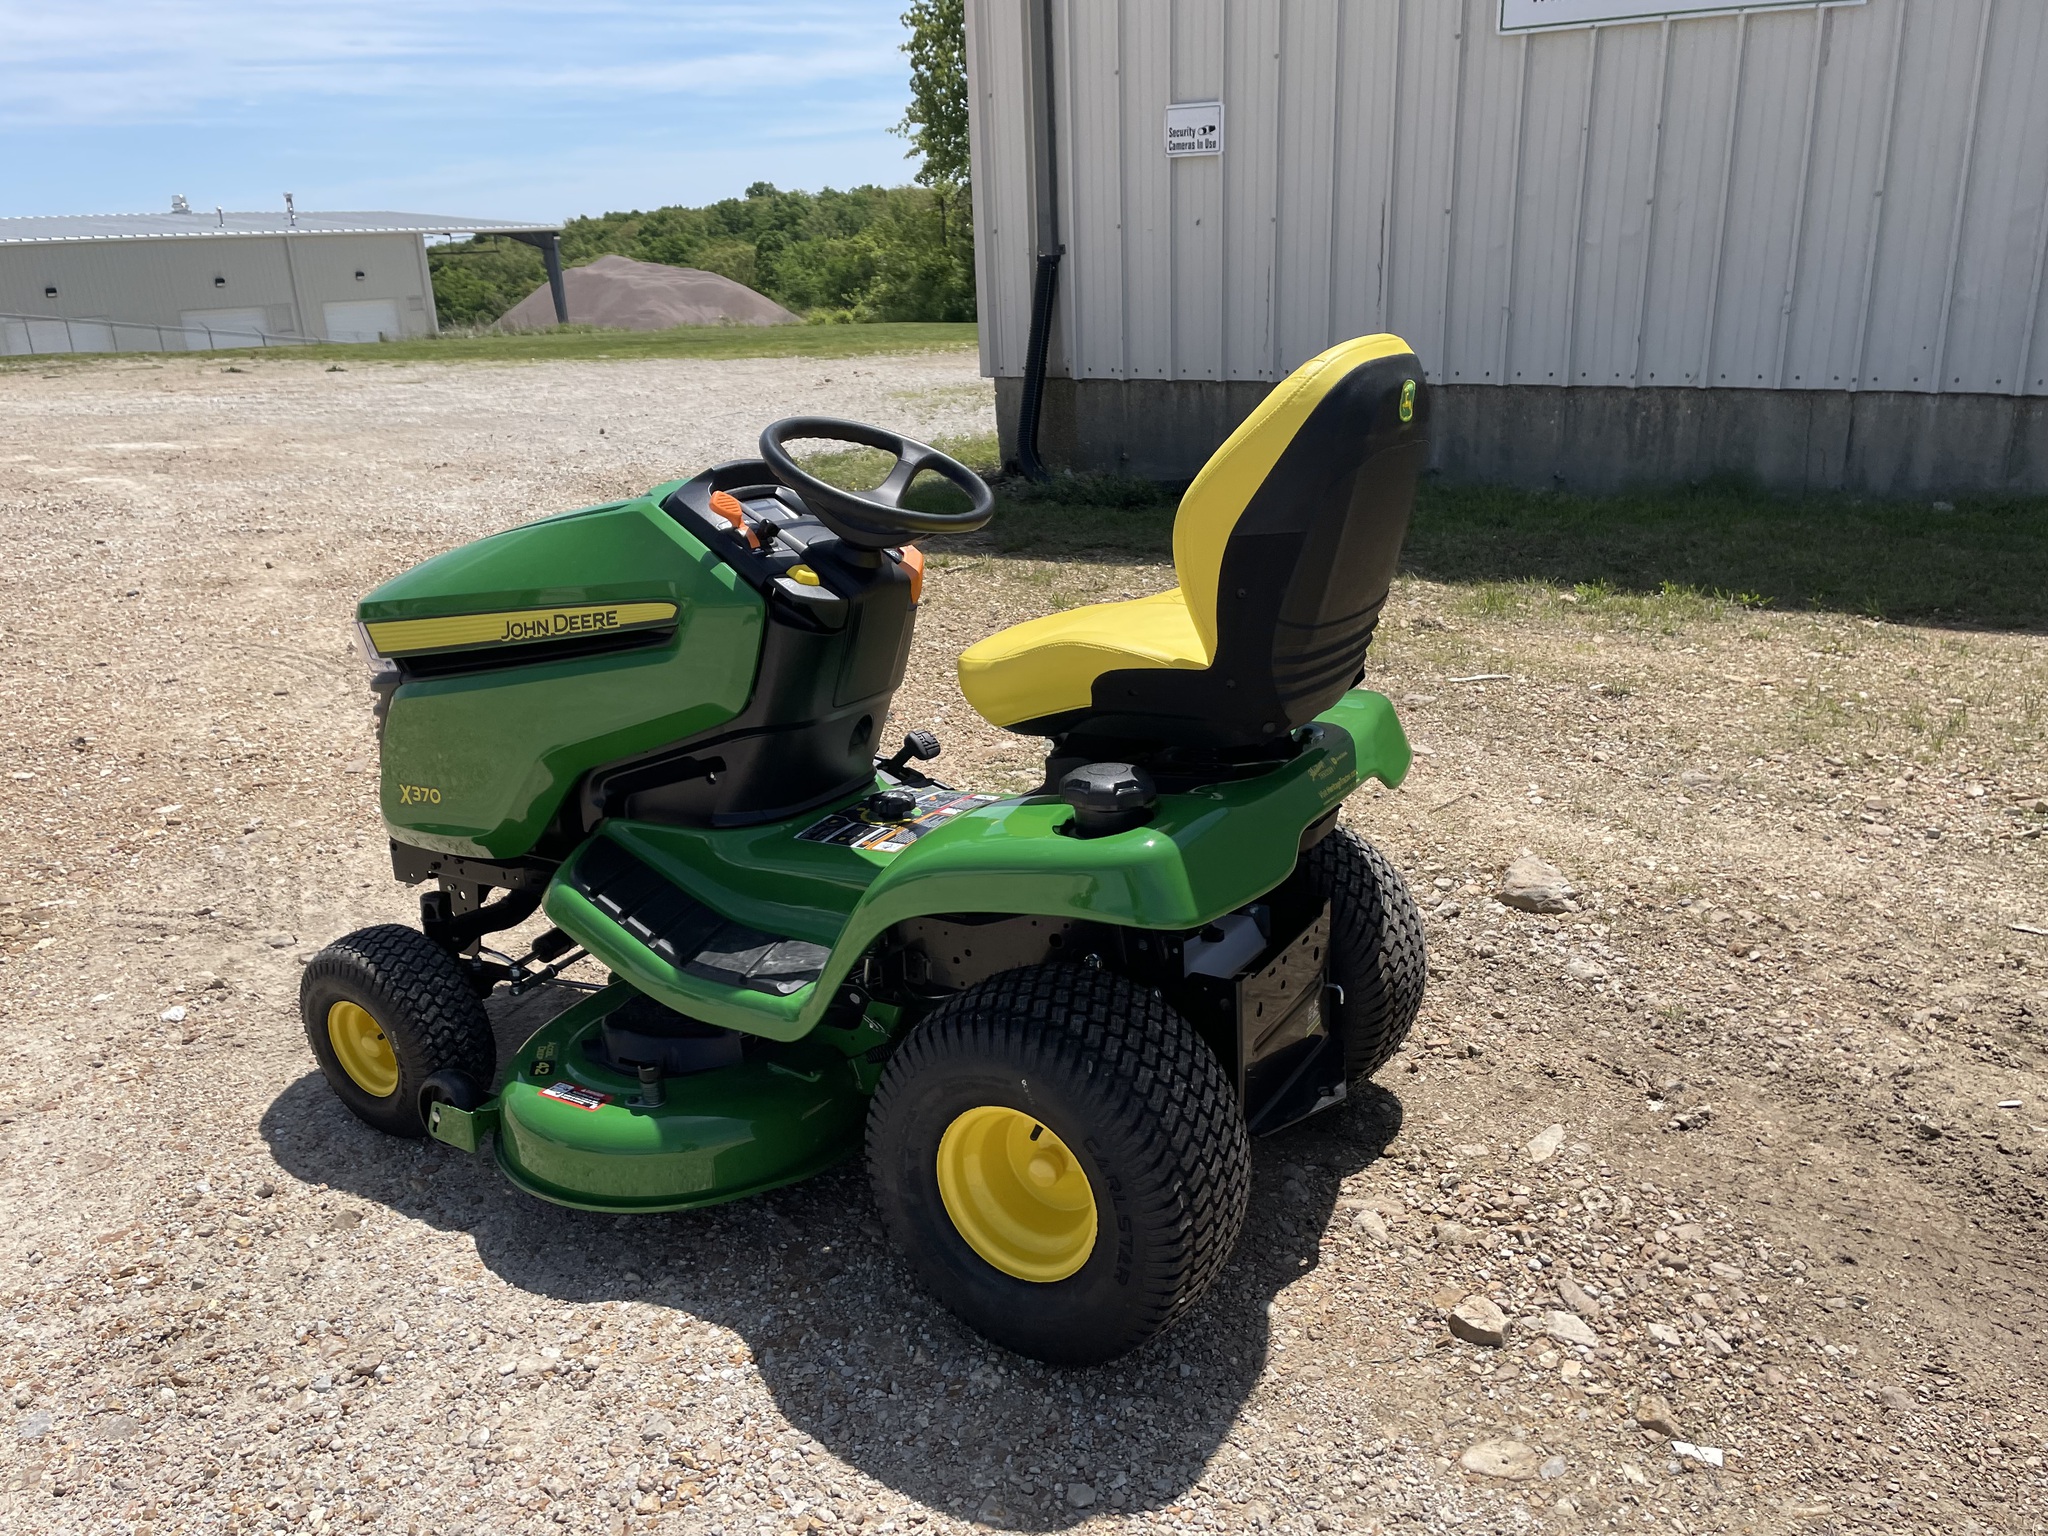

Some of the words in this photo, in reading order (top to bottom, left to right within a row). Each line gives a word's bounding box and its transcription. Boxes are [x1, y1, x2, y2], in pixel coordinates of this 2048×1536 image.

[1169, 126, 1196, 138] Security
[1169, 140, 1195, 151] Cameras
[1197, 139, 1203, 149] In
[1205, 138, 1216, 149] Use
[501, 618, 549, 640] JOHN
[553, 610, 618, 633] DEERE
[399, 784, 441, 805] X370
[534, 1062, 550, 1076] 42
